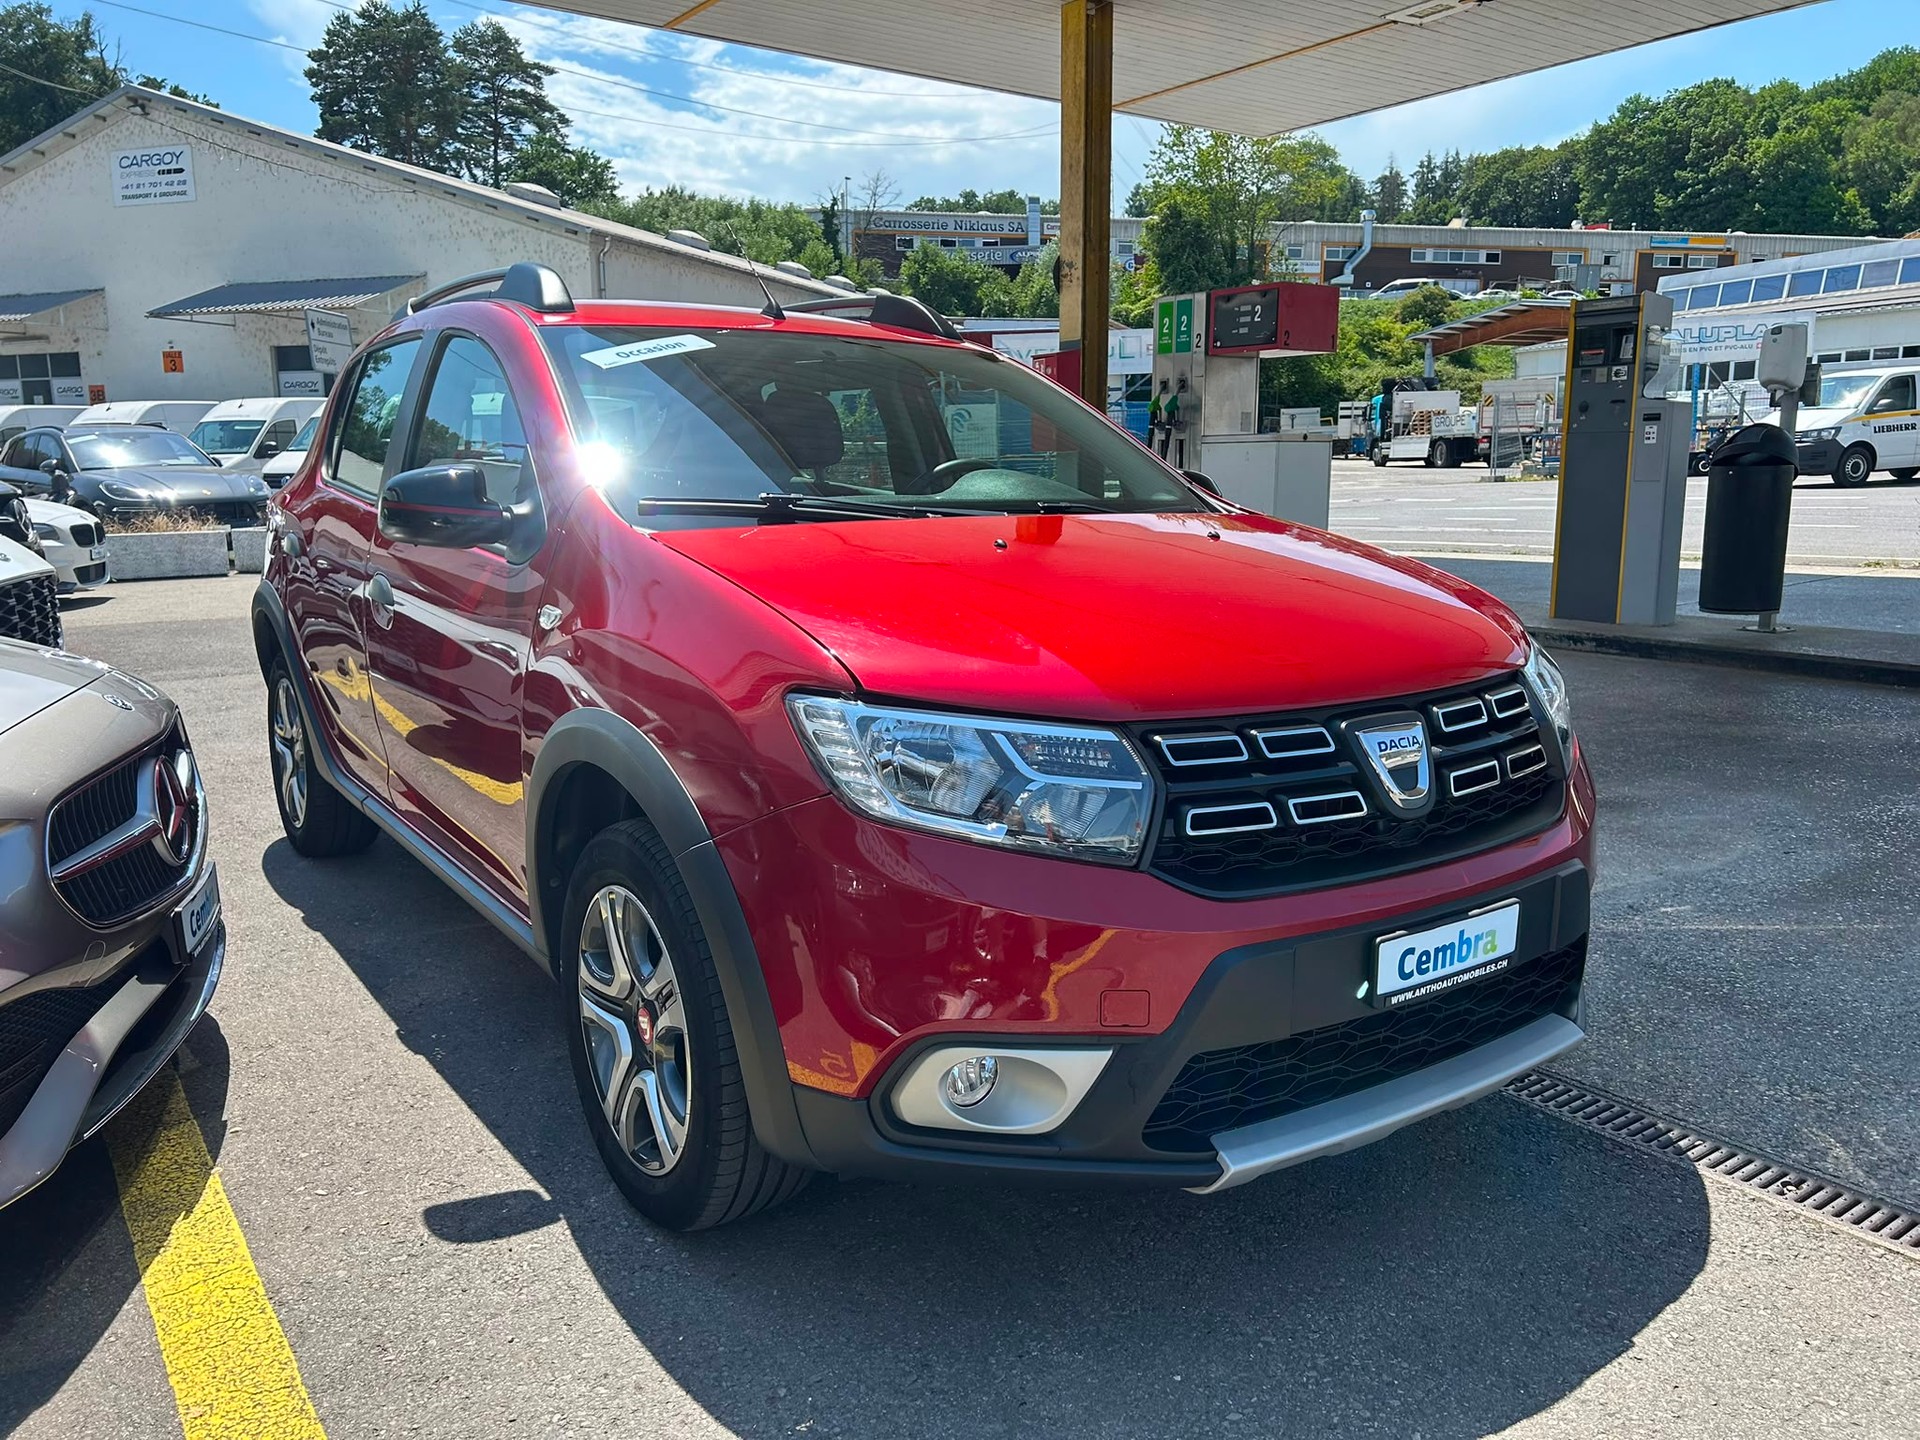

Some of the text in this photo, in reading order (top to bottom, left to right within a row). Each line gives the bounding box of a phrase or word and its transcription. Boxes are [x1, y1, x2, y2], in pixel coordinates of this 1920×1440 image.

[119, 151, 184, 169] CARGOY
[159, 190, 188, 198] GROUPAGE
[873, 217, 1025, 233] Carrosserie Niklaus SA
[1254, 305, 1261, 321] 2
[1163, 318, 1169, 332] 2
[1181, 315, 1187, 331] 2
[1195, 333, 1201, 348] 2
[1283, 330, 1290, 346] 2
[616, 341, 686, 358] Occasion
[1699, 345, 1713, 353] PVC
[1724, 343, 1754, 351] PVC-ALU
[169, 359, 177, 371] 3
[283, 380, 319, 389] CARGOY
[90, 389, 105, 401] 3B
[1434, 415, 1466, 427] GROUPE
[1873, 423, 1917, 433] LIEBHERR
[1377, 735, 1421, 752] DACIA
[1397, 928, 1499, 982] Cembra
[1391, 959, 1508, 1005] WWW.ANTHOAUTOMOBILES.CH
